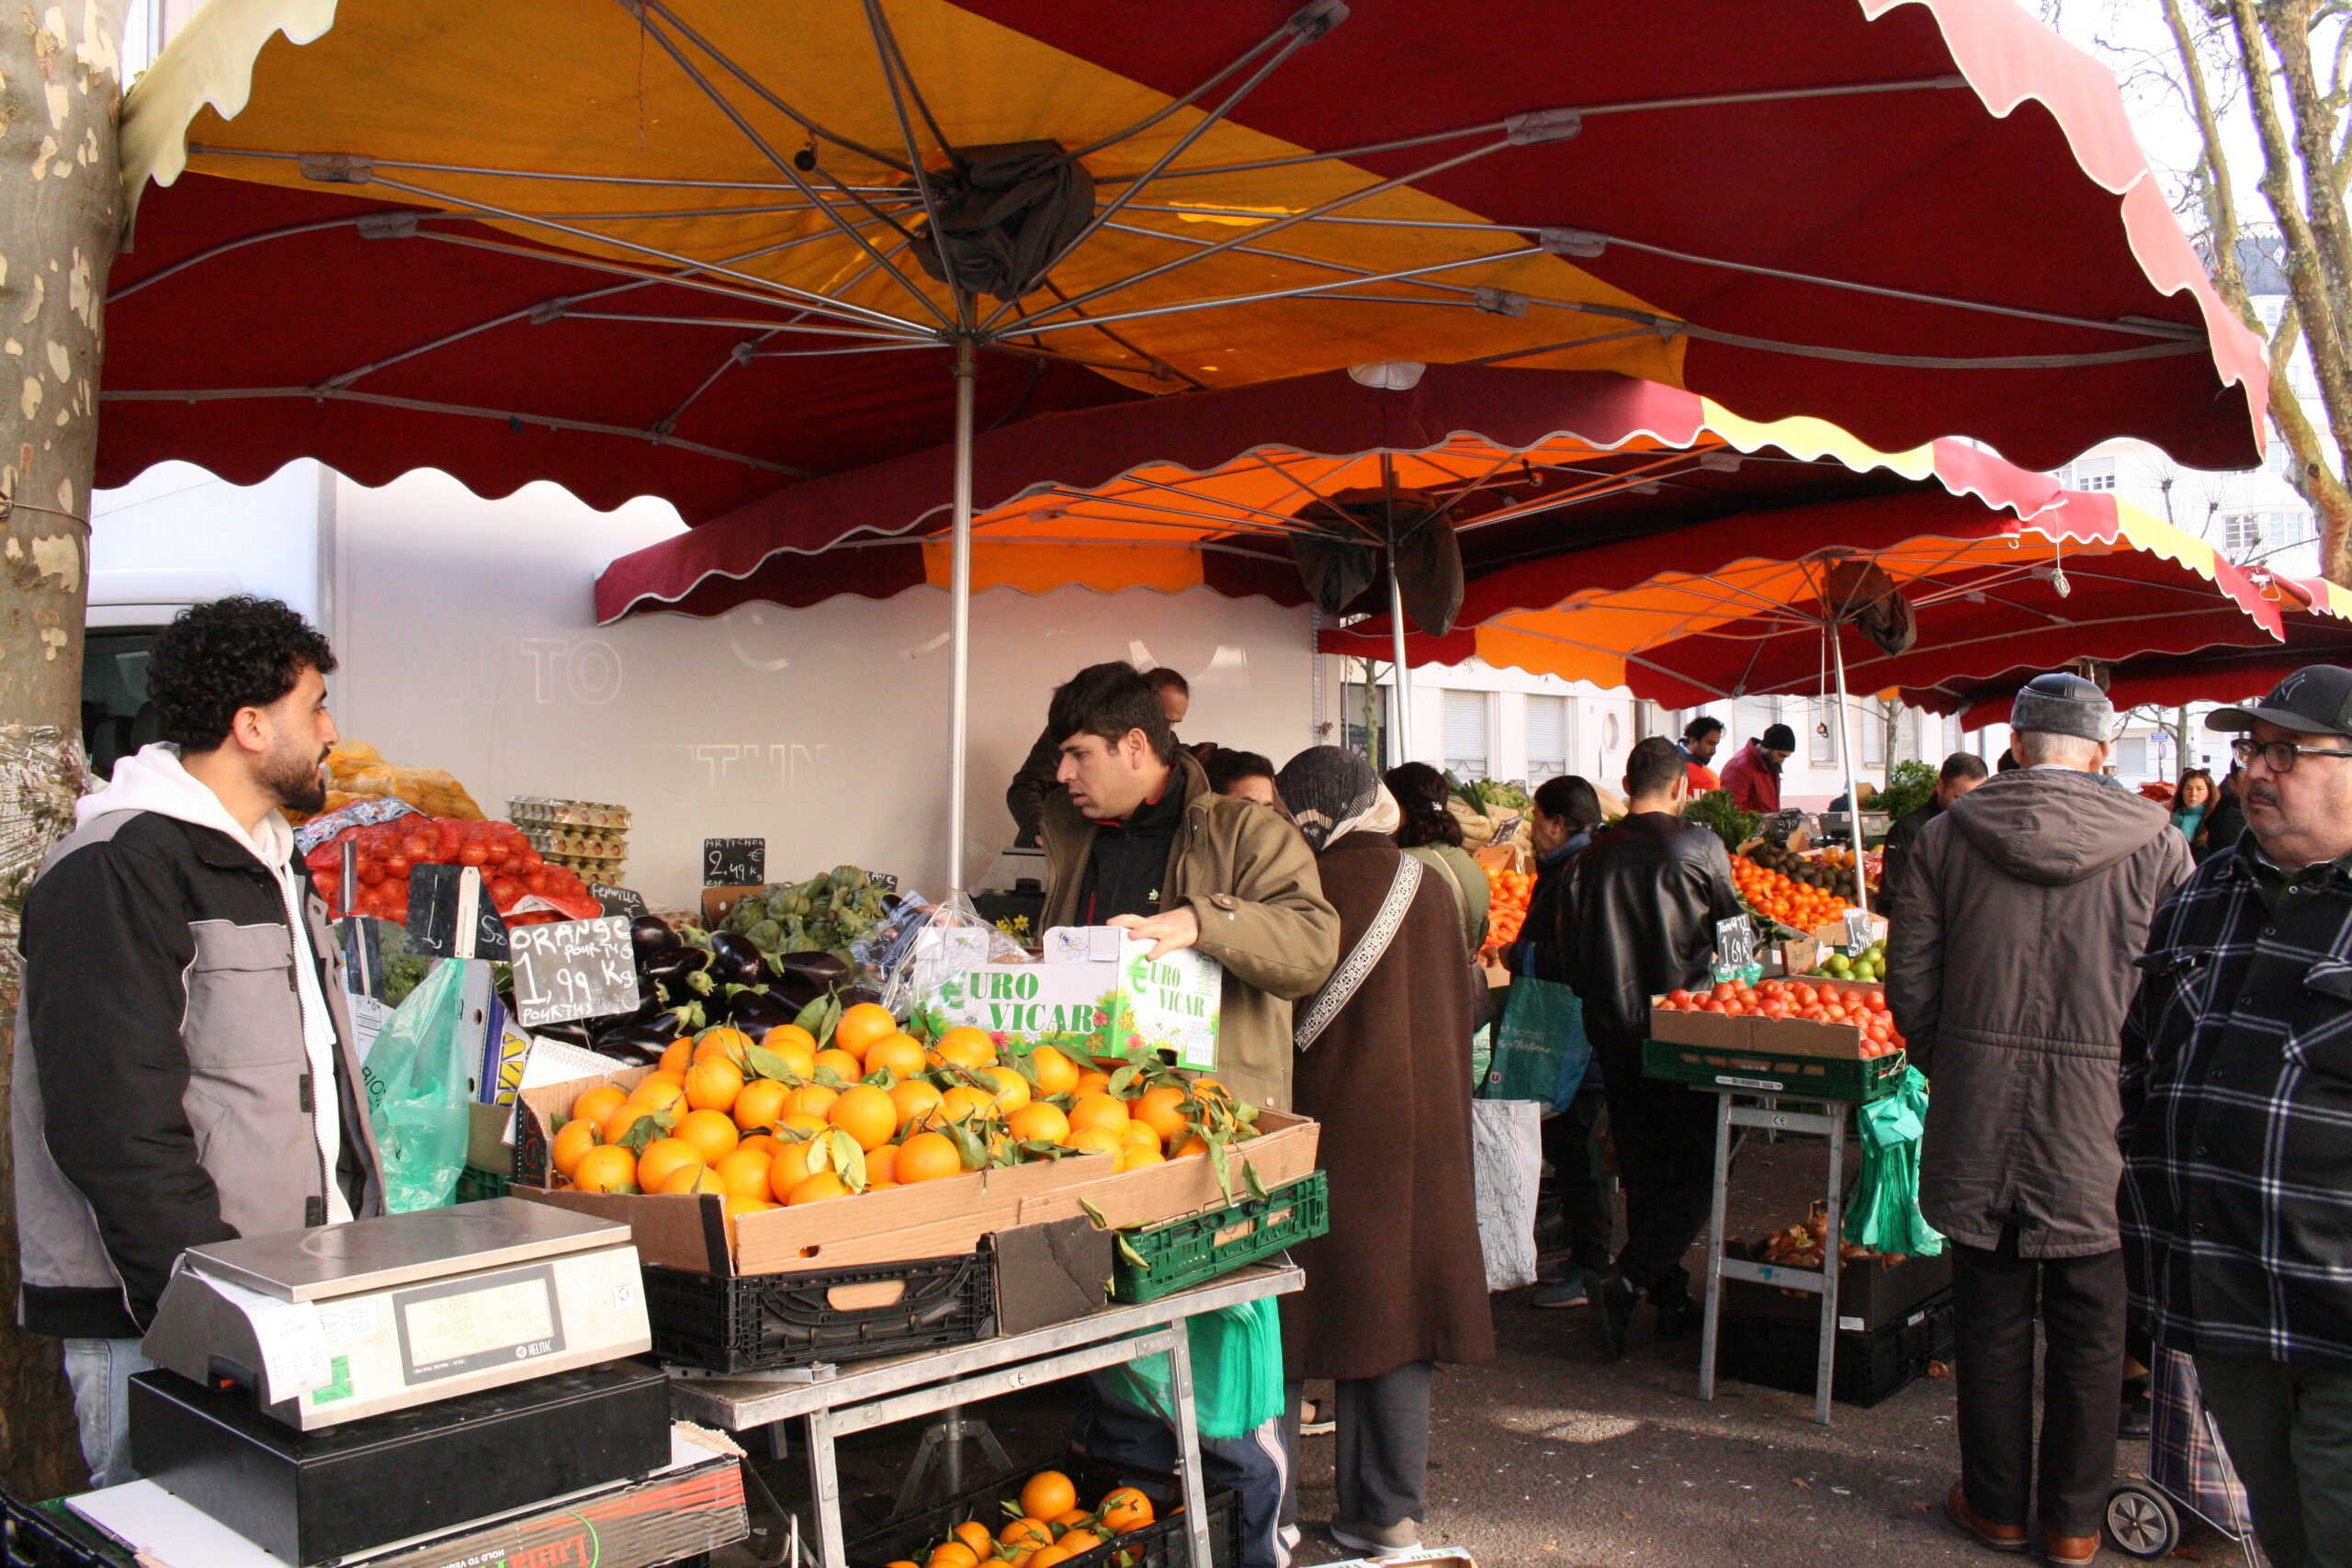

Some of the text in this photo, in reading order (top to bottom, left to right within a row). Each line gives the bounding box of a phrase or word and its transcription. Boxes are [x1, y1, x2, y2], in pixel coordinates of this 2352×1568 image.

[1159, 987, 1205, 1018] VICAR
[988, 1003, 1096, 1032] VICAR
[468, 1556, 481, 1566] TO
[481, 1548, 505, 1563] HOLD
